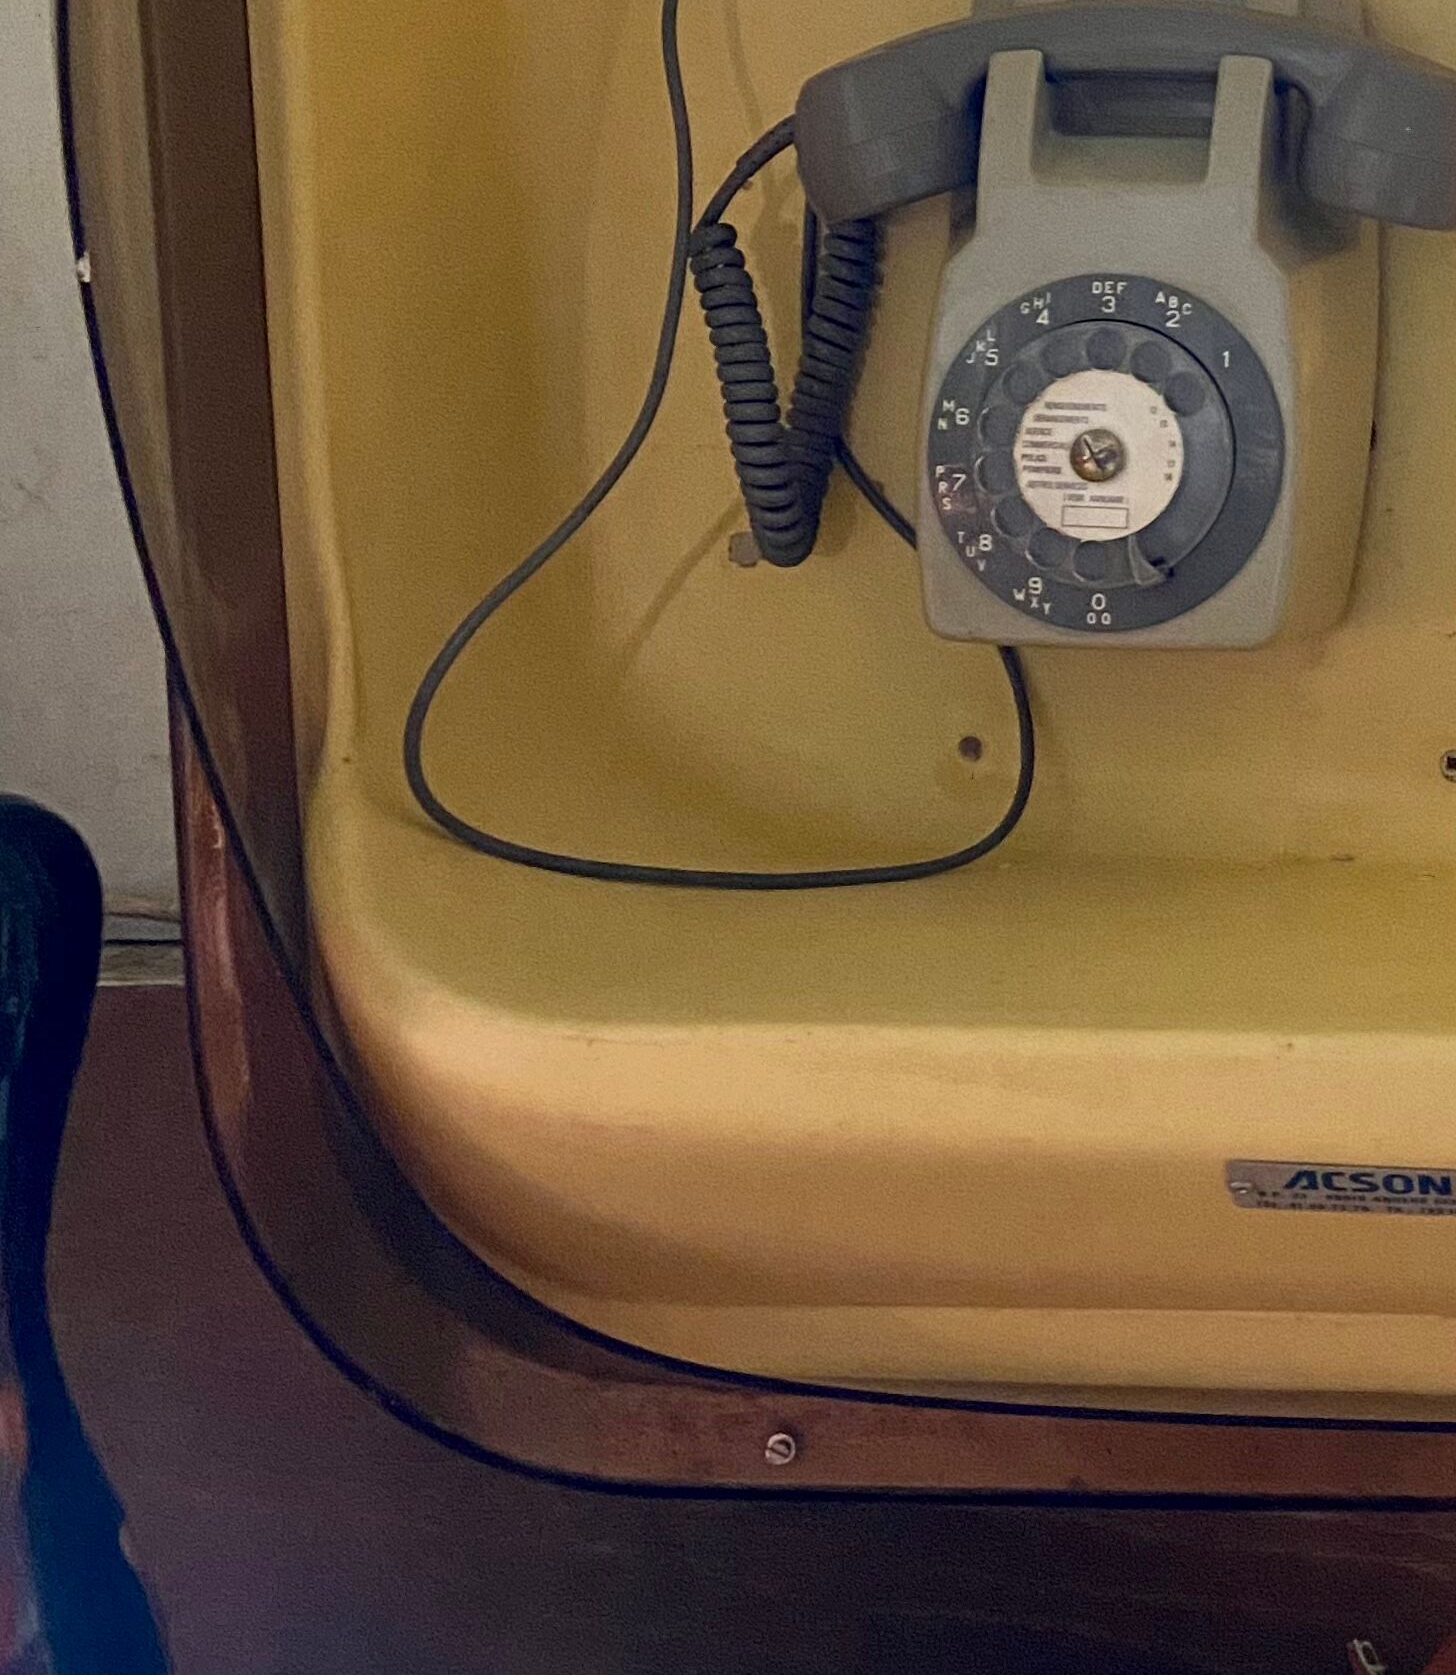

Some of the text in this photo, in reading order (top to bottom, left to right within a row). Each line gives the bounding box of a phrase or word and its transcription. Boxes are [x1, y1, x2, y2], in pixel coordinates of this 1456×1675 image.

[1091, 281, 1127, 294] DEF
[1101, 295, 1116, 313] 3
[1035, 308, 1049, 325] 4
[1165, 310, 1181, 327] 2
[984, 348, 999, 367] 5
[1222, 350, 1230, 368] 1
[955, 408, 970, 426] 6
[951, 473, 967, 492] 7
[978, 534, 993, 552] 8
[1028, 577, 1043, 595] 9
[1091, 593, 1106, 611] 0
[1284, 1170, 1453, 1196] ACSON
